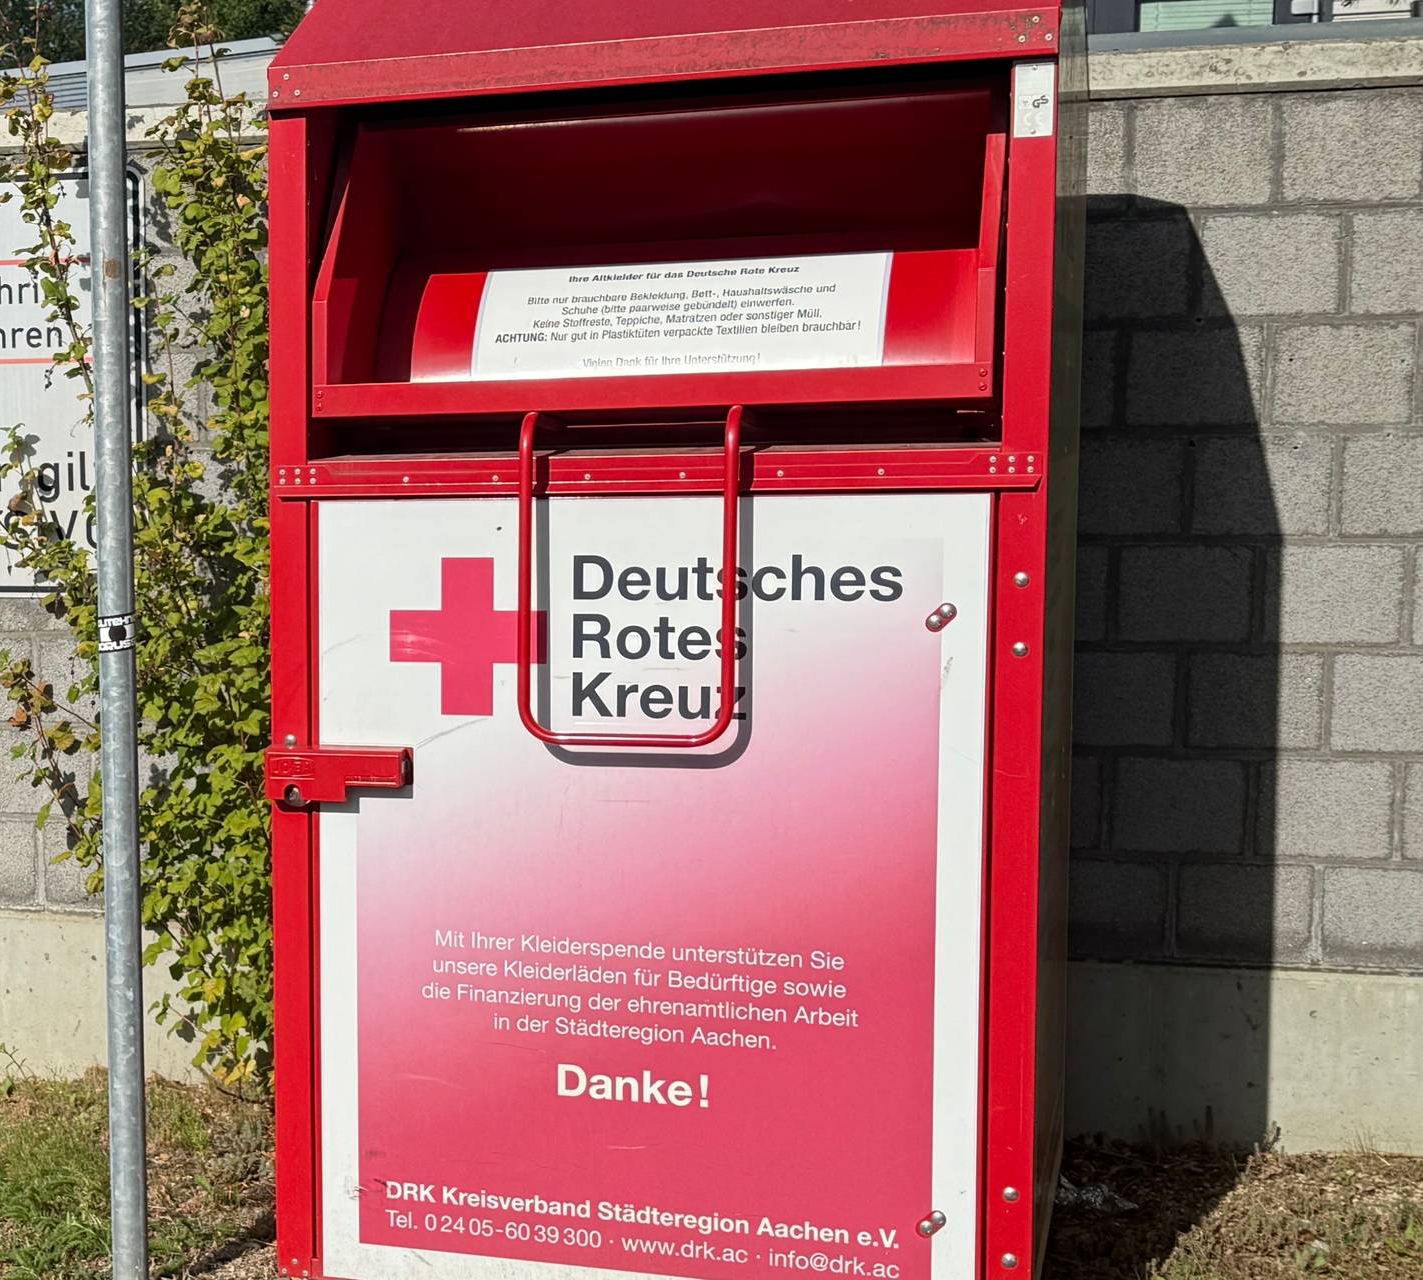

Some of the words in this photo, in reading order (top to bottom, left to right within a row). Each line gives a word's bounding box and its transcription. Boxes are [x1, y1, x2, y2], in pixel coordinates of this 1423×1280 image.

[528, 296, 550, 305] Bitte
[553, 296, 569, 304] nur
[571, 293, 627, 303] brauchbare
[723, 285, 813, 297] Haushaltswäsche
[816, 284, 836, 293] und
[569, 275, 589, 284] Ihre
[592, 272, 643, 282] Altkleider
[646, 271, 661, 280] für
[664, 271, 683, 279] das
[687, 268, 737, 278] Deutsche
[740, 267, 765, 275] Rote
[768, 266, 800, 274] Kreuz
[533, 319, 560, 329] Keine
[563, 317, 613, 328] Stoffreste,
[617, 315, 662, 326] Teppiche,
[665, 312, 717, 323] Matratzen
[720, 311, 743, 321] oder
[746, 309, 794, 321] sonstiger
[797, 308, 822, 318] Müll.
[562, 305, 598, 315] Schuhe
[601, 304, 626, 315] (bitte
[629, 302, 681, 314] paarweise
[683, 299, 737, 312] gebündelt)
[741, 298, 795, 308] einwerfen.
[495, 332, 548, 343] ACHTUNG:
[550, 331, 567, 341] Nur
[570, 331, 587, 343] gut
[589, 330, 599, 340] in
[602, 327, 660, 340] Plastiktüten
[663, 325, 713, 338] verpackte
[716, 323, 758, 335] Textilien
[761, 322, 799, 334] bleiben
[802, 320, 861, 332] brauchbar!
[582, 357, 612, 368] Vielen
[616, 356, 641, 367] Dank
[644, 355, 659, 366] für
[662, 354, 682, 365] Ihre
[684, 352, 761, 366] Unterstützung!
[38, 451, 95, 503] gil
[572, 554, 903, 602] Deutsches
[572, 613, 747, 661] Rotes
[572, 672, 747, 721] Kreuz
[435, 929, 464, 948] Mit
[471, 931, 515, 951] Ihrer
[521, 934, 665, 960] Kleiderspende
[672, 944, 803, 968] unterstützen
[810, 950, 844, 971] Sie
[433, 959, 498, 977] unsere
[504, 959, 627, 985] Kleiderläden
[633, 967, 661, 987] für
[668, 970, 777, 998] Bedürftige
[783, 979, 846, 999] sowie
[422, 982, 451, 1000] die
[457, 983, 581, 1013] Finanzierung
[588, 993, 622, 1011] der
[627, 995, 787, 1024] ehrenamtlichen
[794, 1005, 859, 1028] Arbeit
[494, 1013, 510, 1031] in
[516, 1015, 549, 1034] der
[555, 1016, 684, 1046] Städteregion
[691, 1026, 777, 1050] Aachen.
[386, 1180, 436, 1203] DRK
[442, 1185, 591, 1219] Kreisverband
[597, 1201, 749, 1235] Städteregion
[756, 1217, 849, 1244] Aachen
[857, 1228, 899, 1249] e.V.
[385, 1209, 418, 1229] Tel.
[621, 1237, 749, 1264] www.drk.ac
[769, 1248, 900, 1279] info@drk.ac
